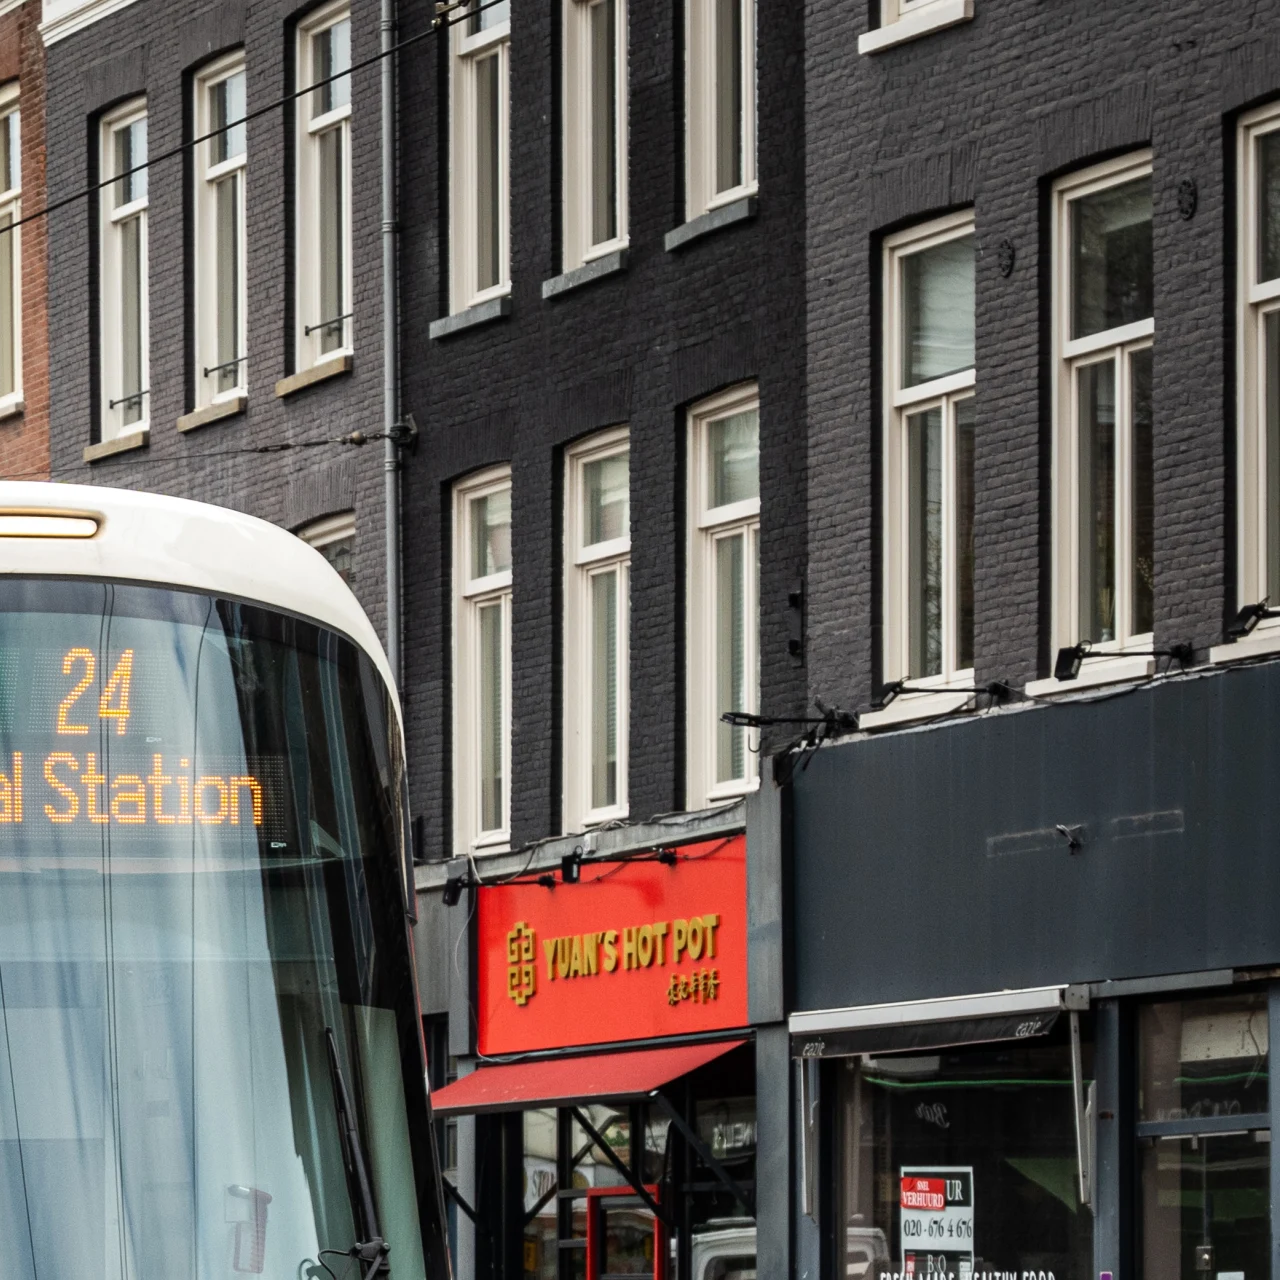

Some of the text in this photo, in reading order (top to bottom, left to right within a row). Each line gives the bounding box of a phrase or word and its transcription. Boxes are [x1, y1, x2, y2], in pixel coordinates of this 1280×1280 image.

[57, 647, 134, 735] 24
[43, 751, 263, 826] Station
[543, 914, 720, 981] YUAN'S HOT POT
[802, 1036, 825, 1056] eazie
[1015, 1016, 1041, 1037] eazie
[902, 1191, 944, 1208] VERHUURD
